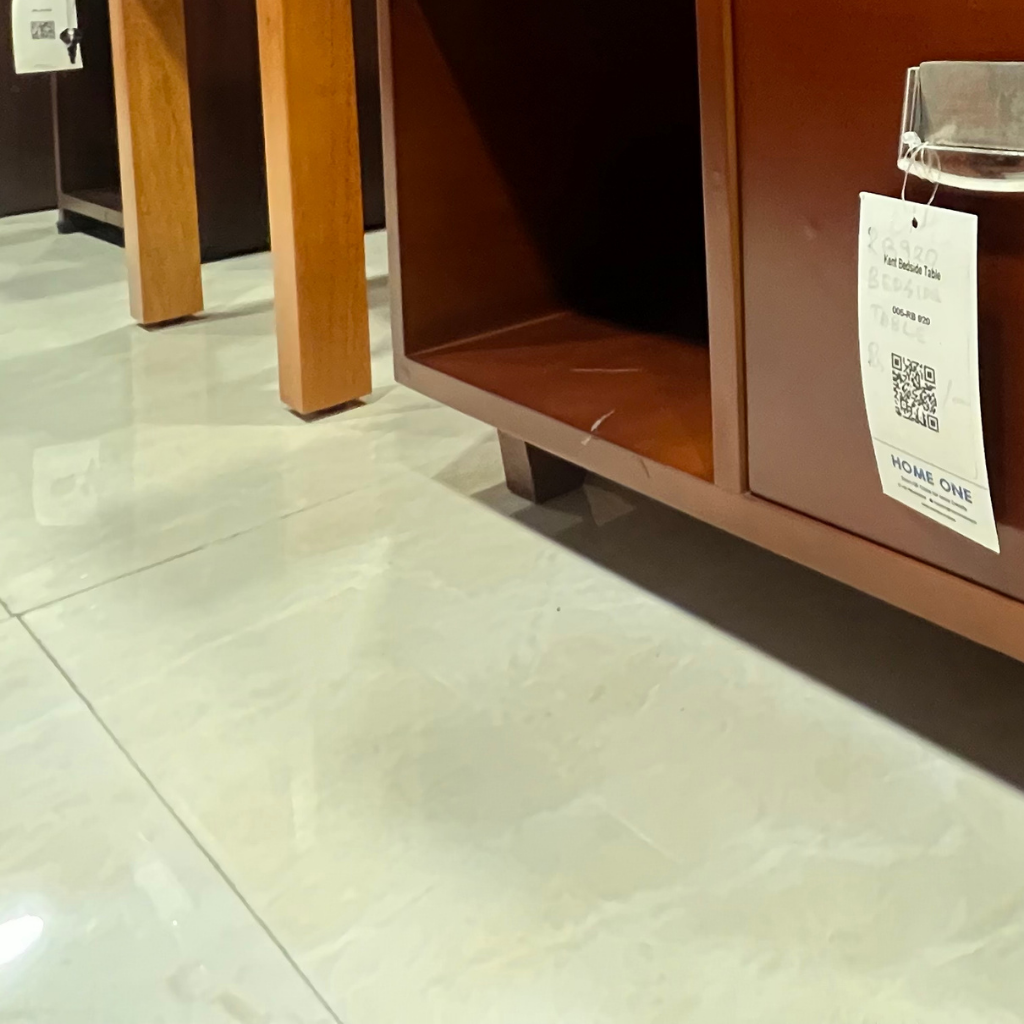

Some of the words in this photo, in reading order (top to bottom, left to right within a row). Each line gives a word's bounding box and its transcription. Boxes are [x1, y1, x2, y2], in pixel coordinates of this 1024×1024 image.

[898, 258, 923, 275] Bedside
[924, 265, 941, 281] Table
[891, 454, 935, 486] HOME
[939, 478, 973, 505] ONE
